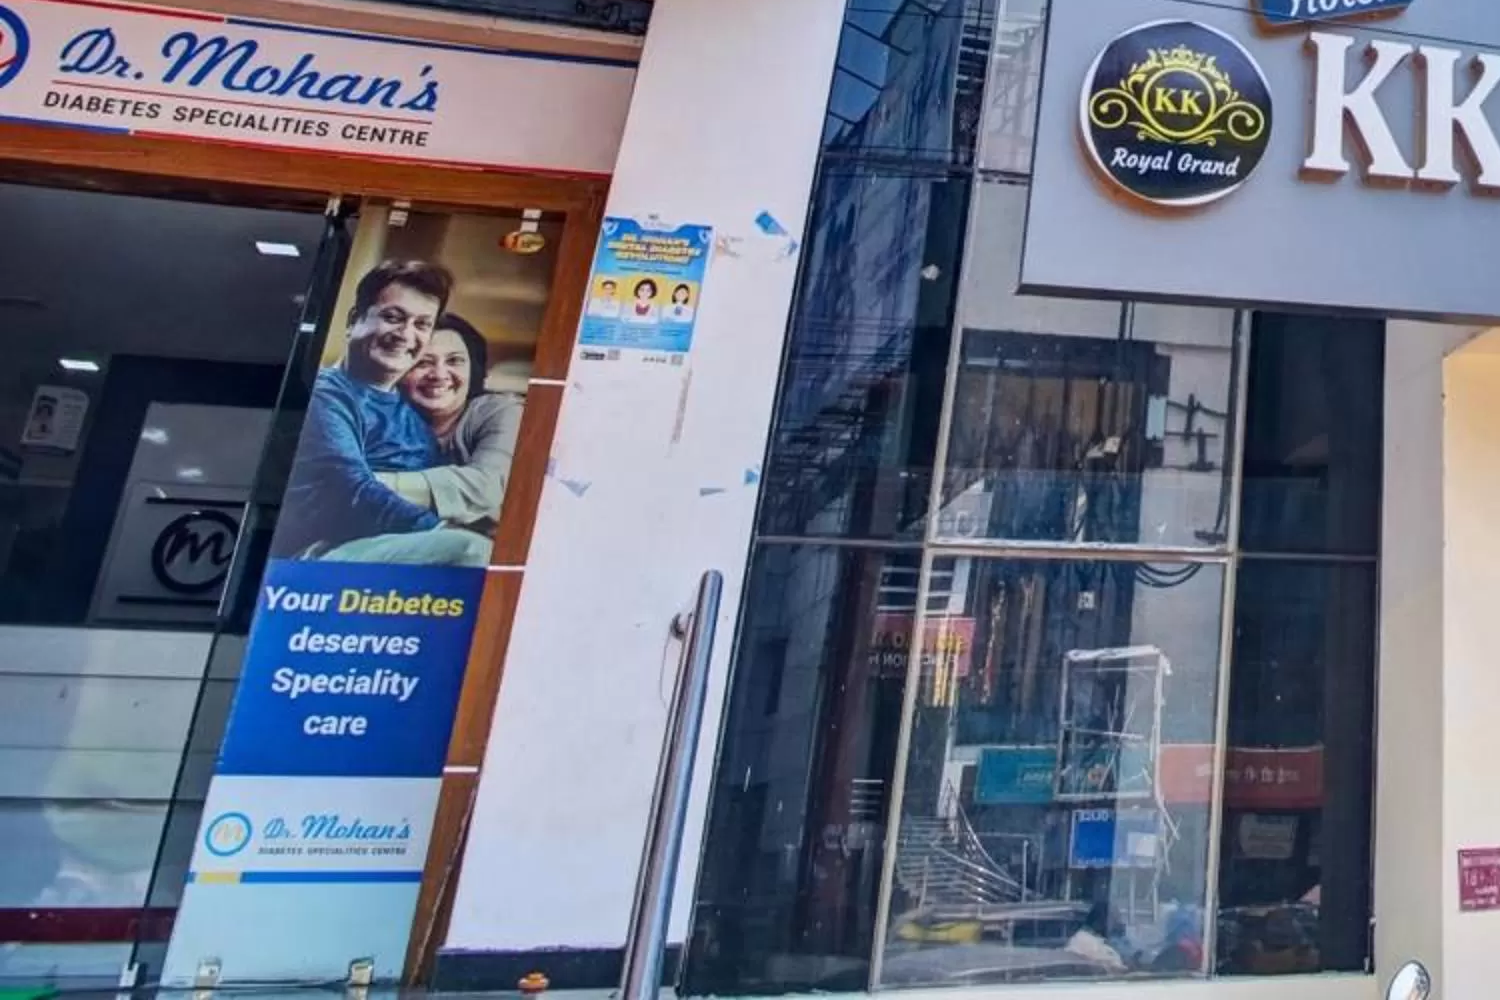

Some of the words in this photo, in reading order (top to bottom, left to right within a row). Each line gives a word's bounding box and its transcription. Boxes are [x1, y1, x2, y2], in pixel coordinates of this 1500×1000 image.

[60, 27, 144, 80] Dr.
[161, 31, 439, 113] Mohan's
[1153, 87, 1204, 117] KK
[43, 91, 162, 119] DIABETES
[172, 106, 330, 137] SPECIALITIES
[341, 123, 429, 147] CENTRE
[1111, 147, 1171, 176] Royal
[1177, 153, 1240, 177] Grand
[264, 585, 333, 612] Your
[338, 588, 465, 617] Diabetes
[288, 625, 421, 656] deserves
[271, 667, 420, 702] Speciality
[303, 714, 368, 736] care
[262, 817, 297, 840] Dr.
[301, 814, 412, 840] Mohan's
